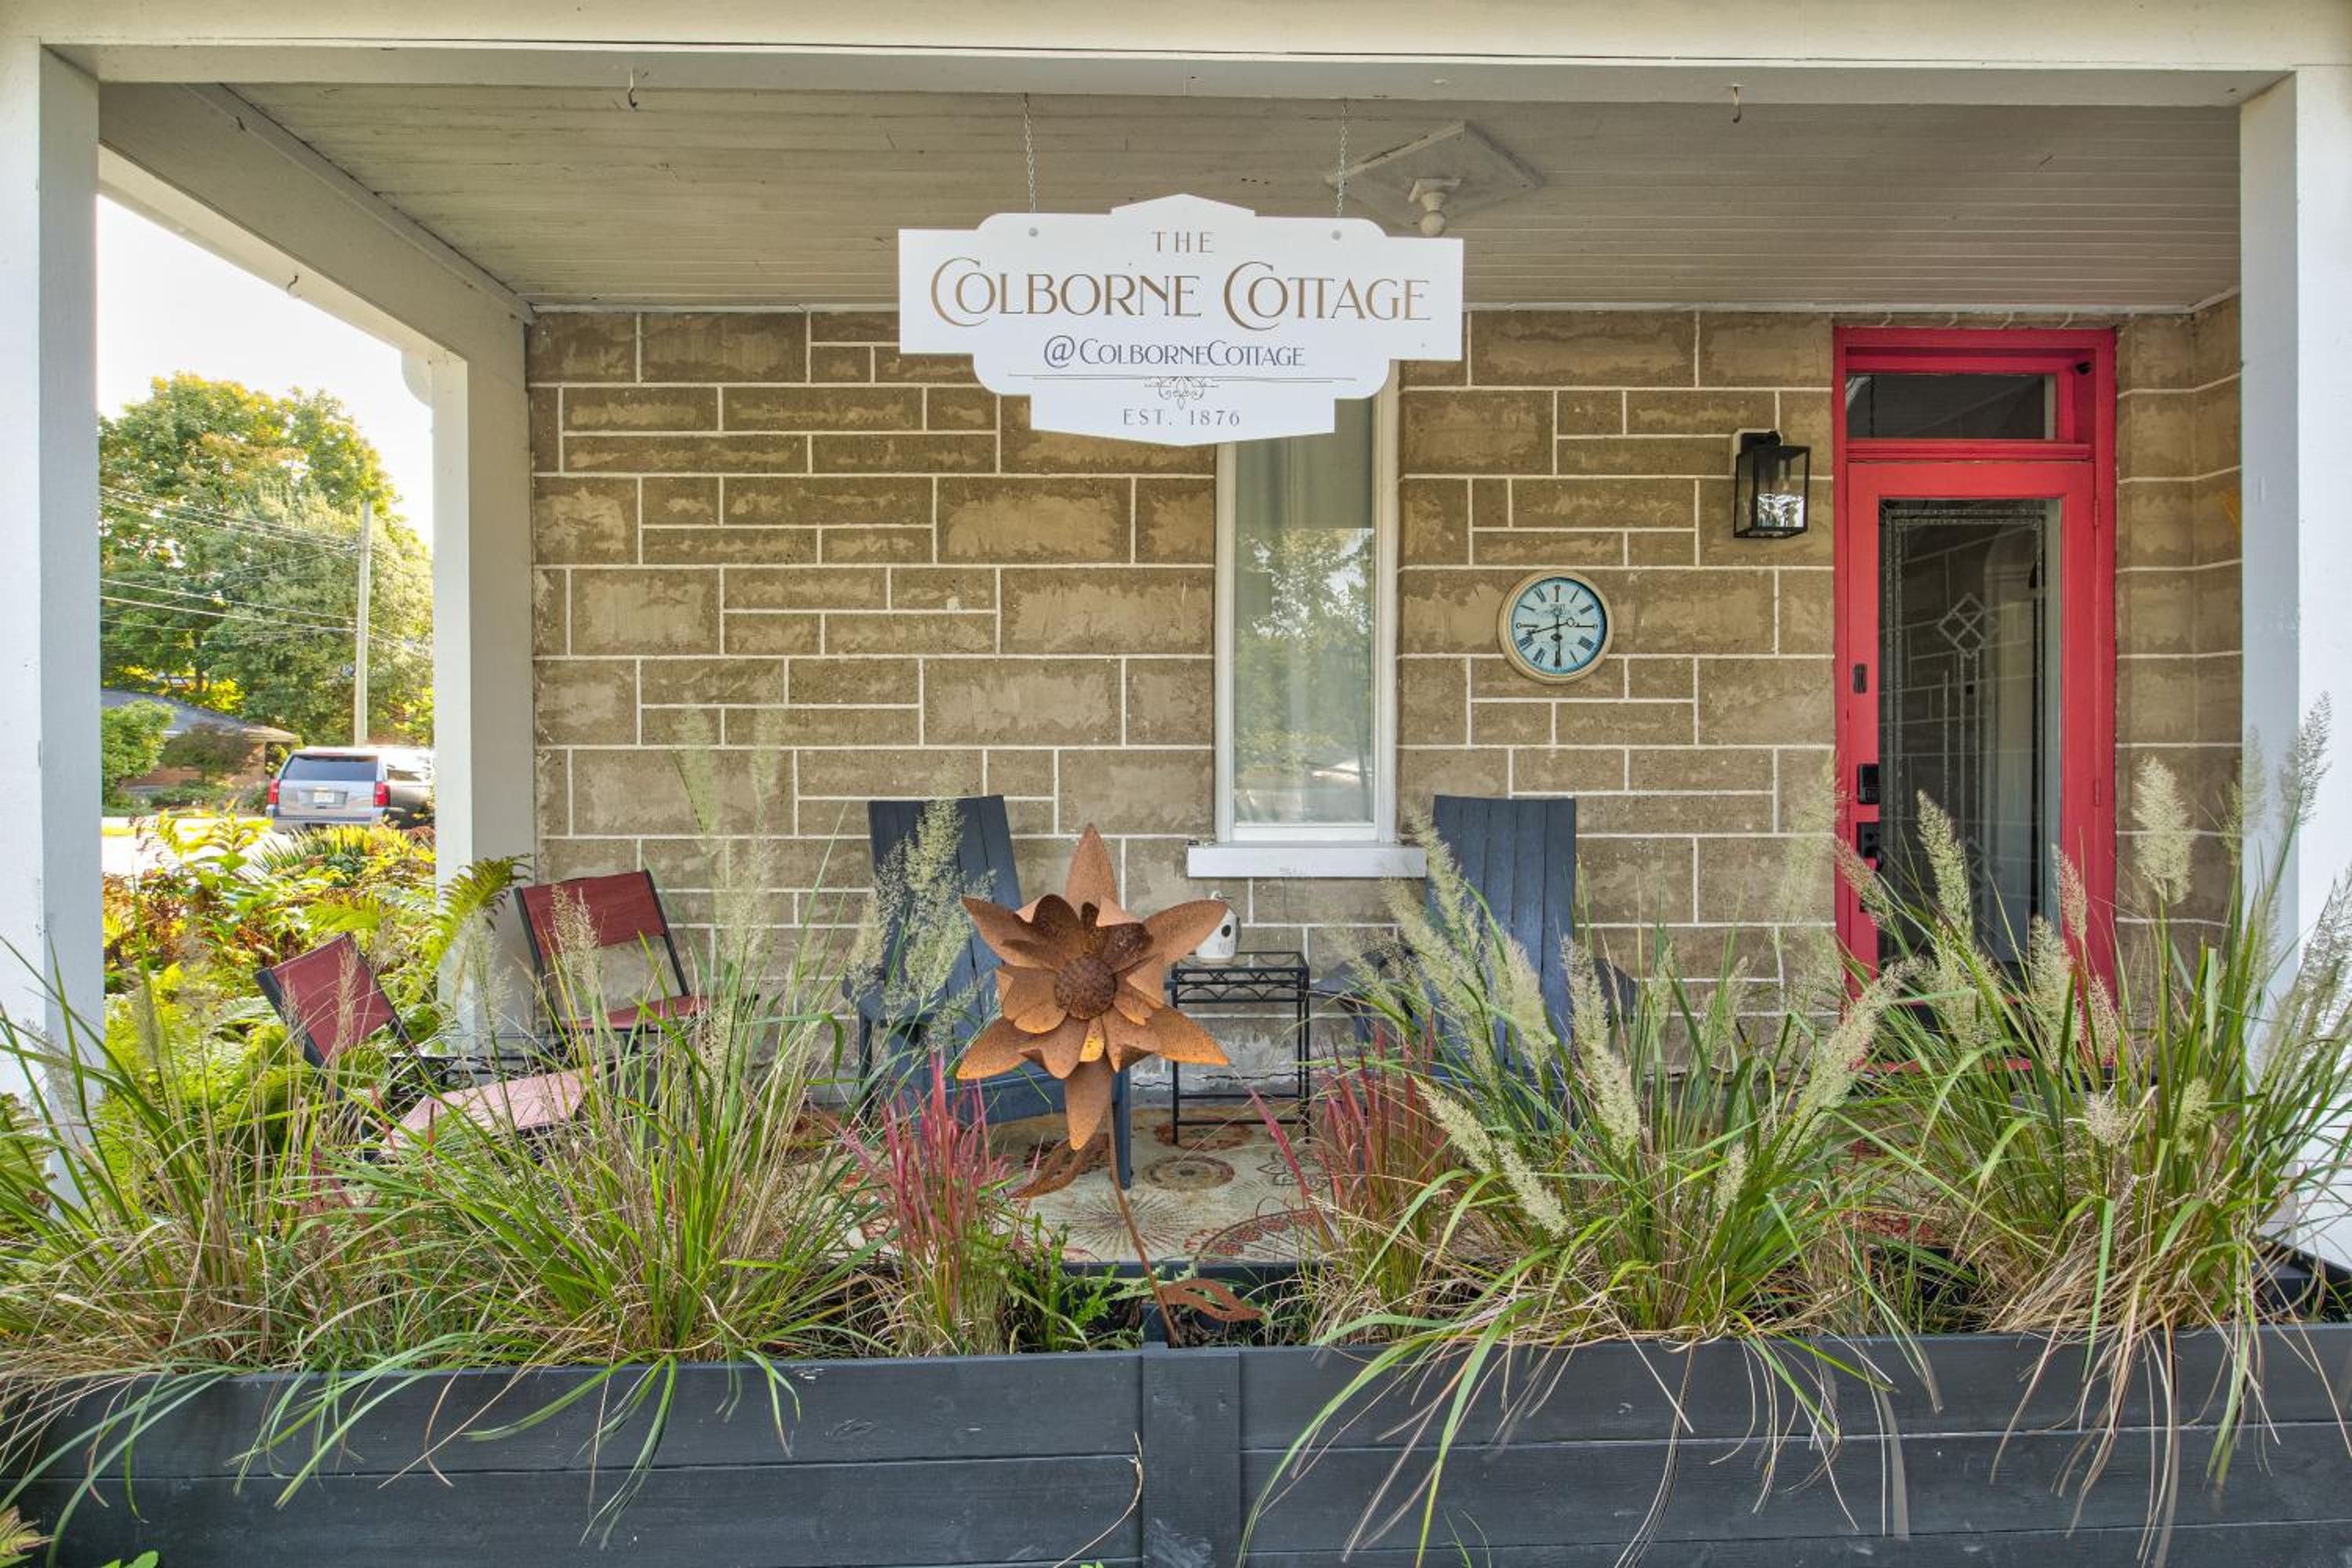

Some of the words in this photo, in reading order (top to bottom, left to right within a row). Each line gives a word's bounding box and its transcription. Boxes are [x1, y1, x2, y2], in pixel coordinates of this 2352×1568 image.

[1152, 231, 1214, 253] THE
[931, 256, 1203, 327] COLBORNE
[1224, 261, 1431, 332] COTTAGE
[1123, 408, 1172, 426] EST.
